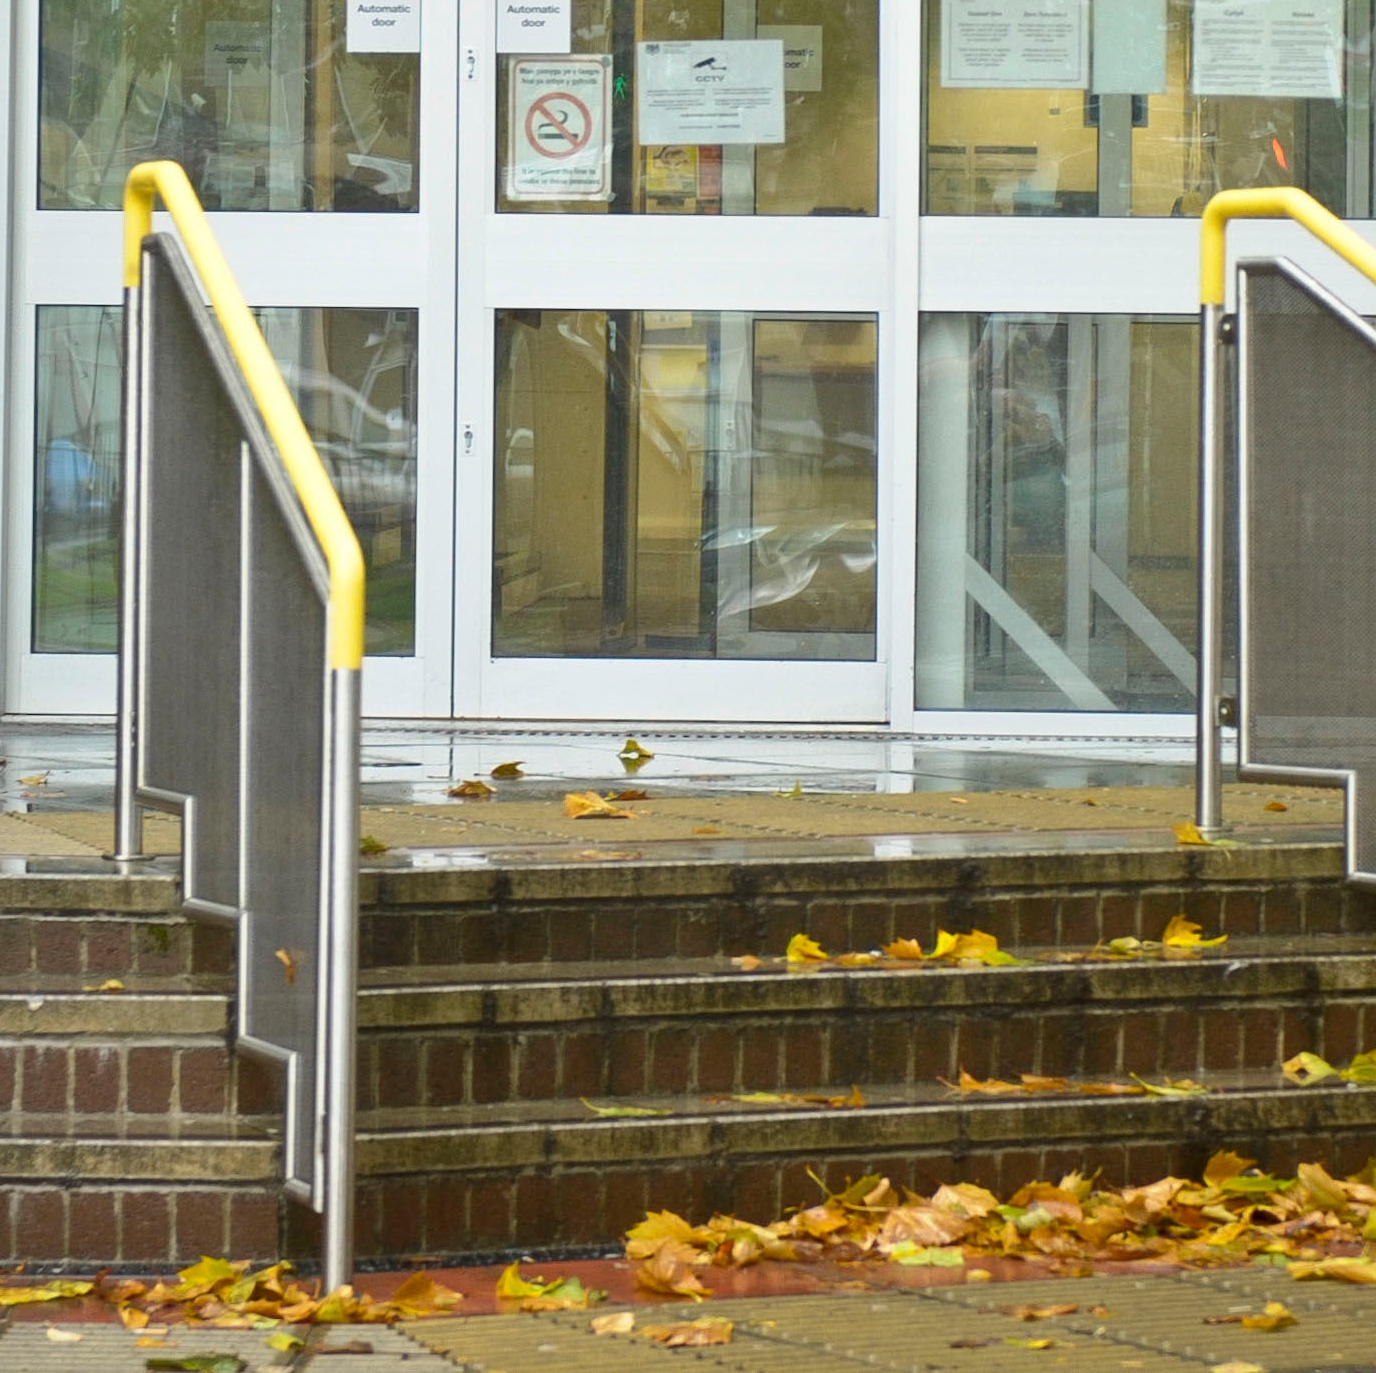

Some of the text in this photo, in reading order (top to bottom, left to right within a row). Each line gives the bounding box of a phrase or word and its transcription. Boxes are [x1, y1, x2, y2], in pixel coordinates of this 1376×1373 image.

[357, 3, 411, 14] Automatic
[507, 4, 560, 15] Automatic
[371, 17, 396, 27] door
[521, 18, 546, 28] door
[695, 75, 725, 83] CCTV
